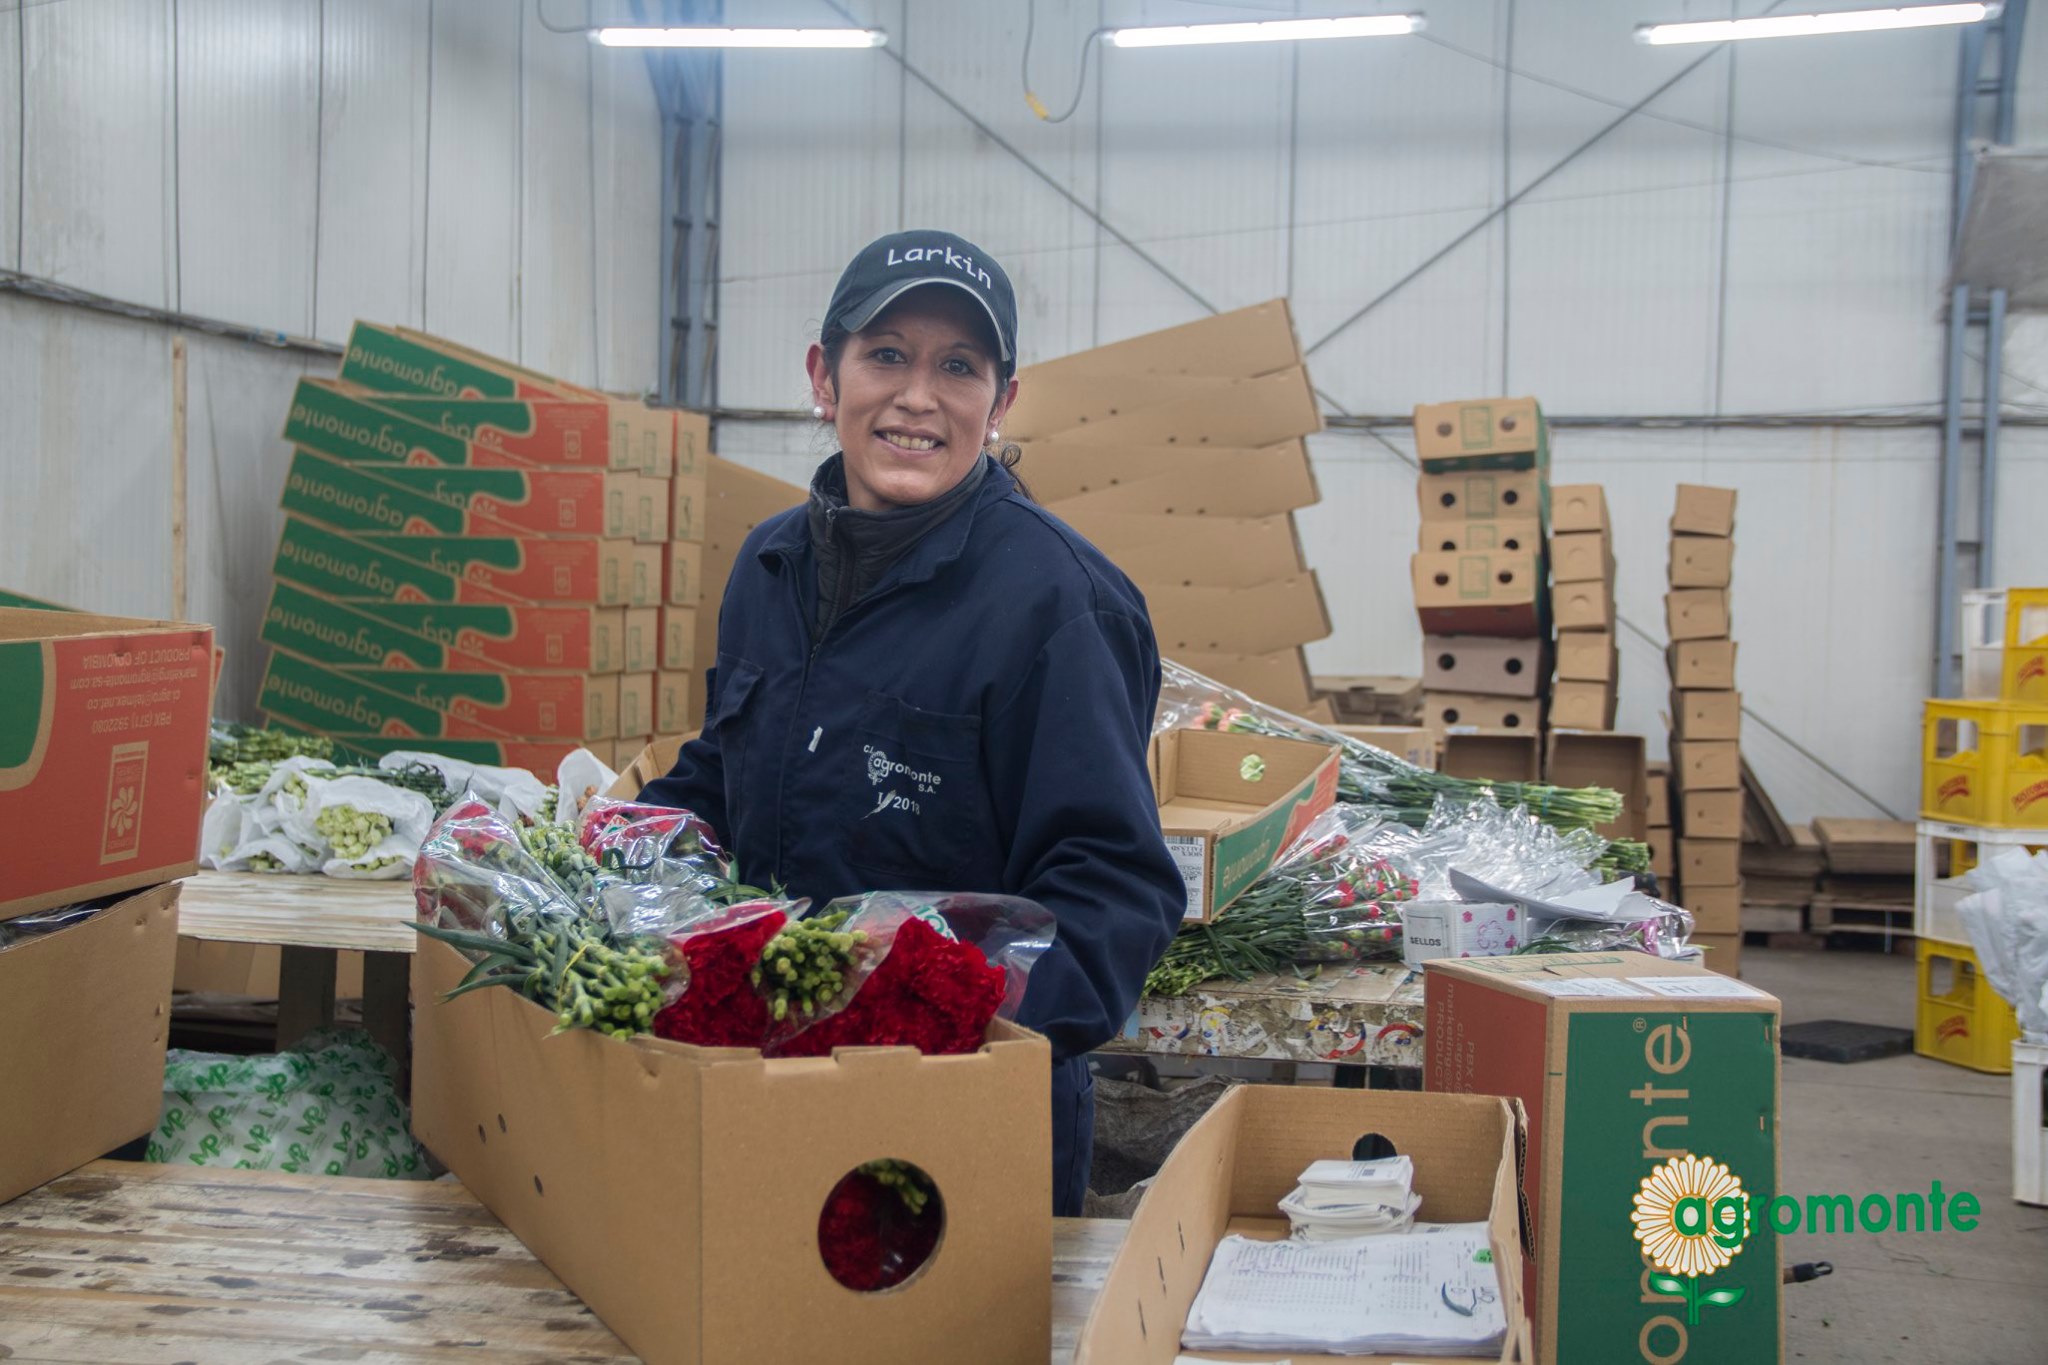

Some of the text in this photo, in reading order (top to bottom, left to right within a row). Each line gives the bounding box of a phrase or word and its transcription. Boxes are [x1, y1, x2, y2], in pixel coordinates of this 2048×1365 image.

[887, 246, 991, 289] Larkin
[918, 784, 937, 794] S.A.
[1410, 936, 1441, 946] SELLOS
[161, 1108, 186, 1139] MP
[189, 1134, 220, 1166] MP
